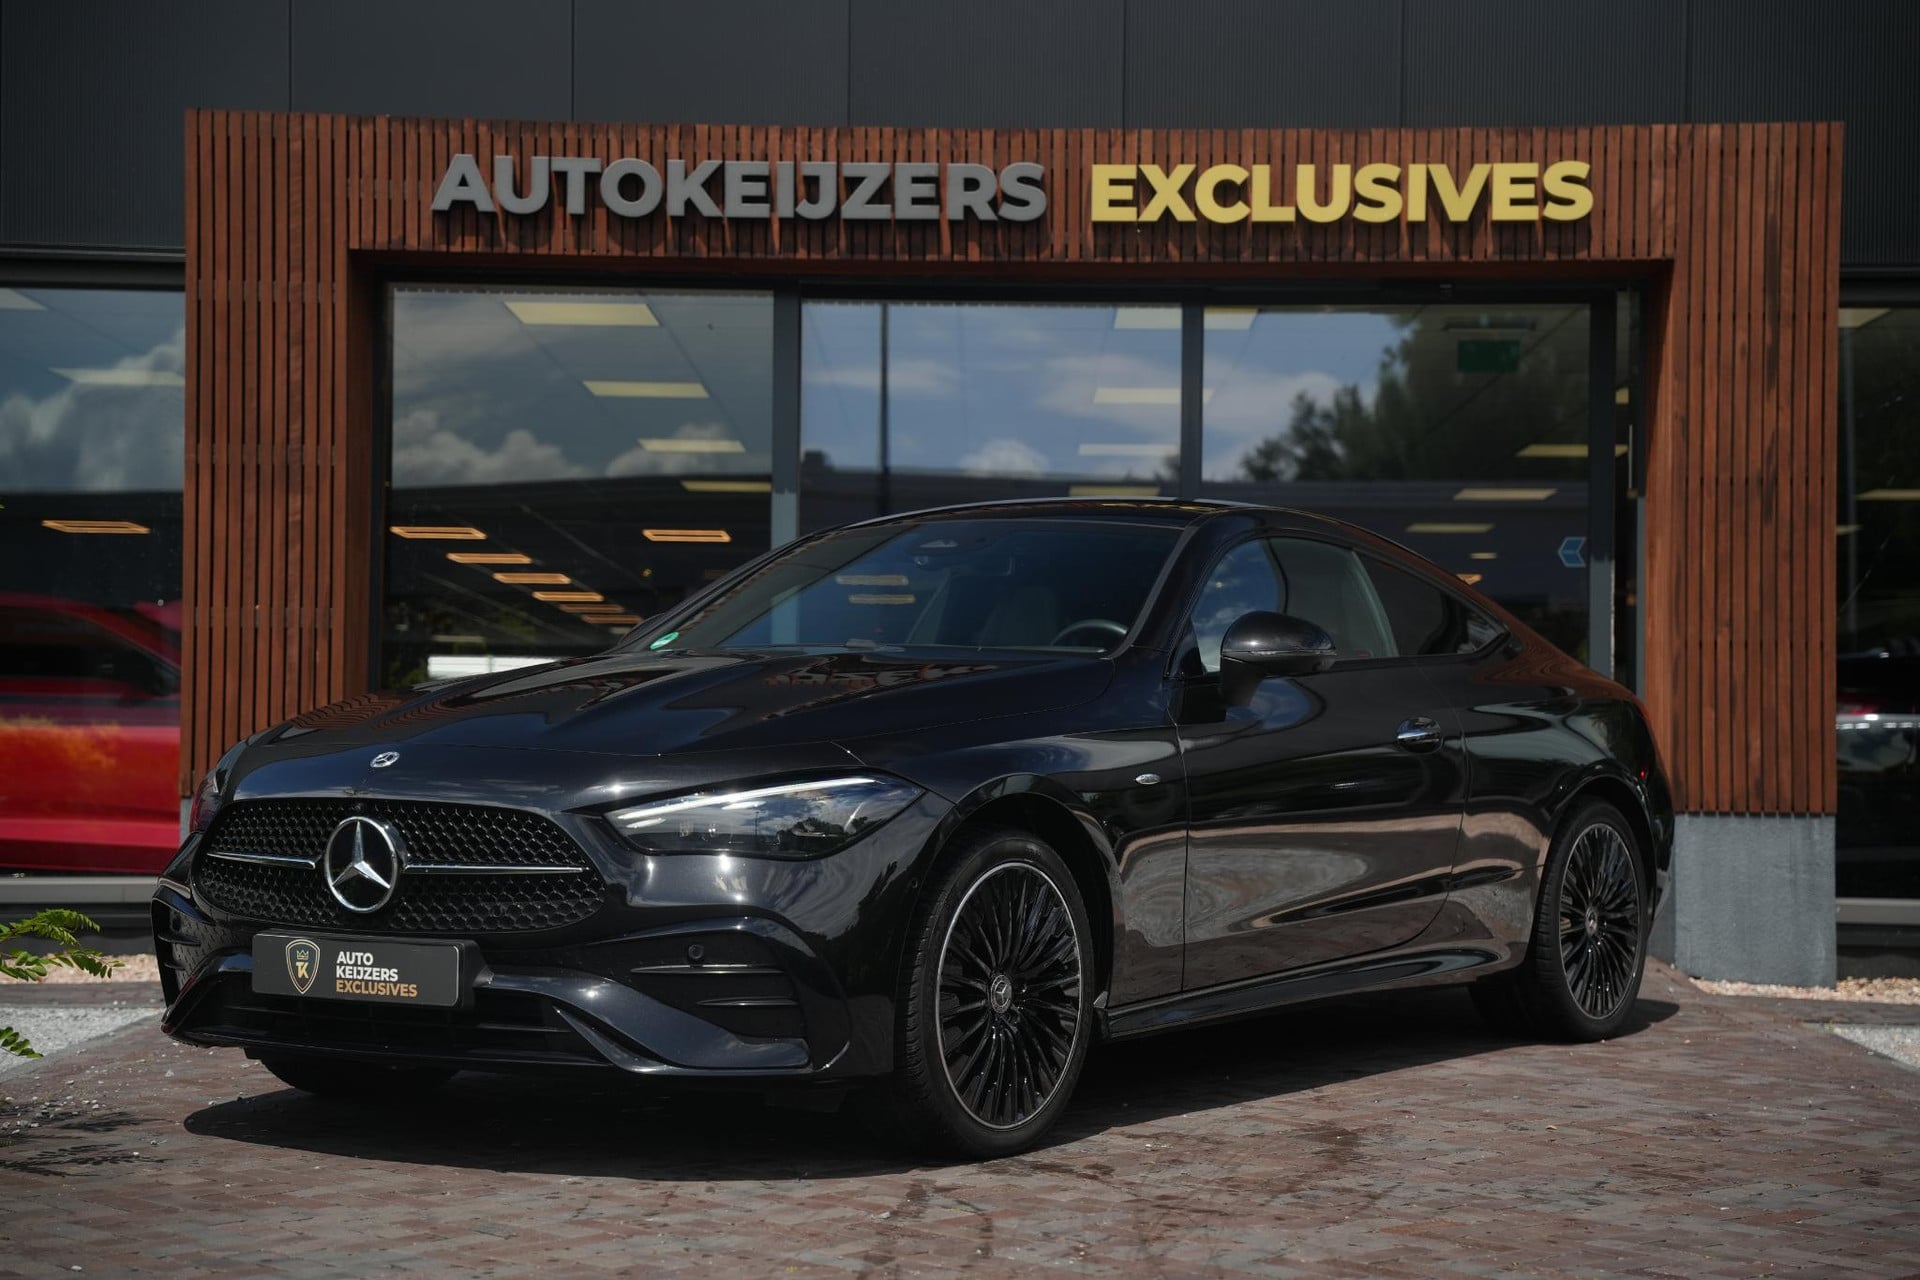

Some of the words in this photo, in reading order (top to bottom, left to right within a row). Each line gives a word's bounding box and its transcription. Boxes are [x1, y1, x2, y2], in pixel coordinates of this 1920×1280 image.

[432, 153, 1048, 223] AUTOKEIJZERS
[1091, 161, 1594, 224] EXCLUSIVES
[336, 951, 374, 966] AUTO
[335, 965, 399, 982] KEIJZERS
[336, 980, 418, 998] EXCLUSIVES
